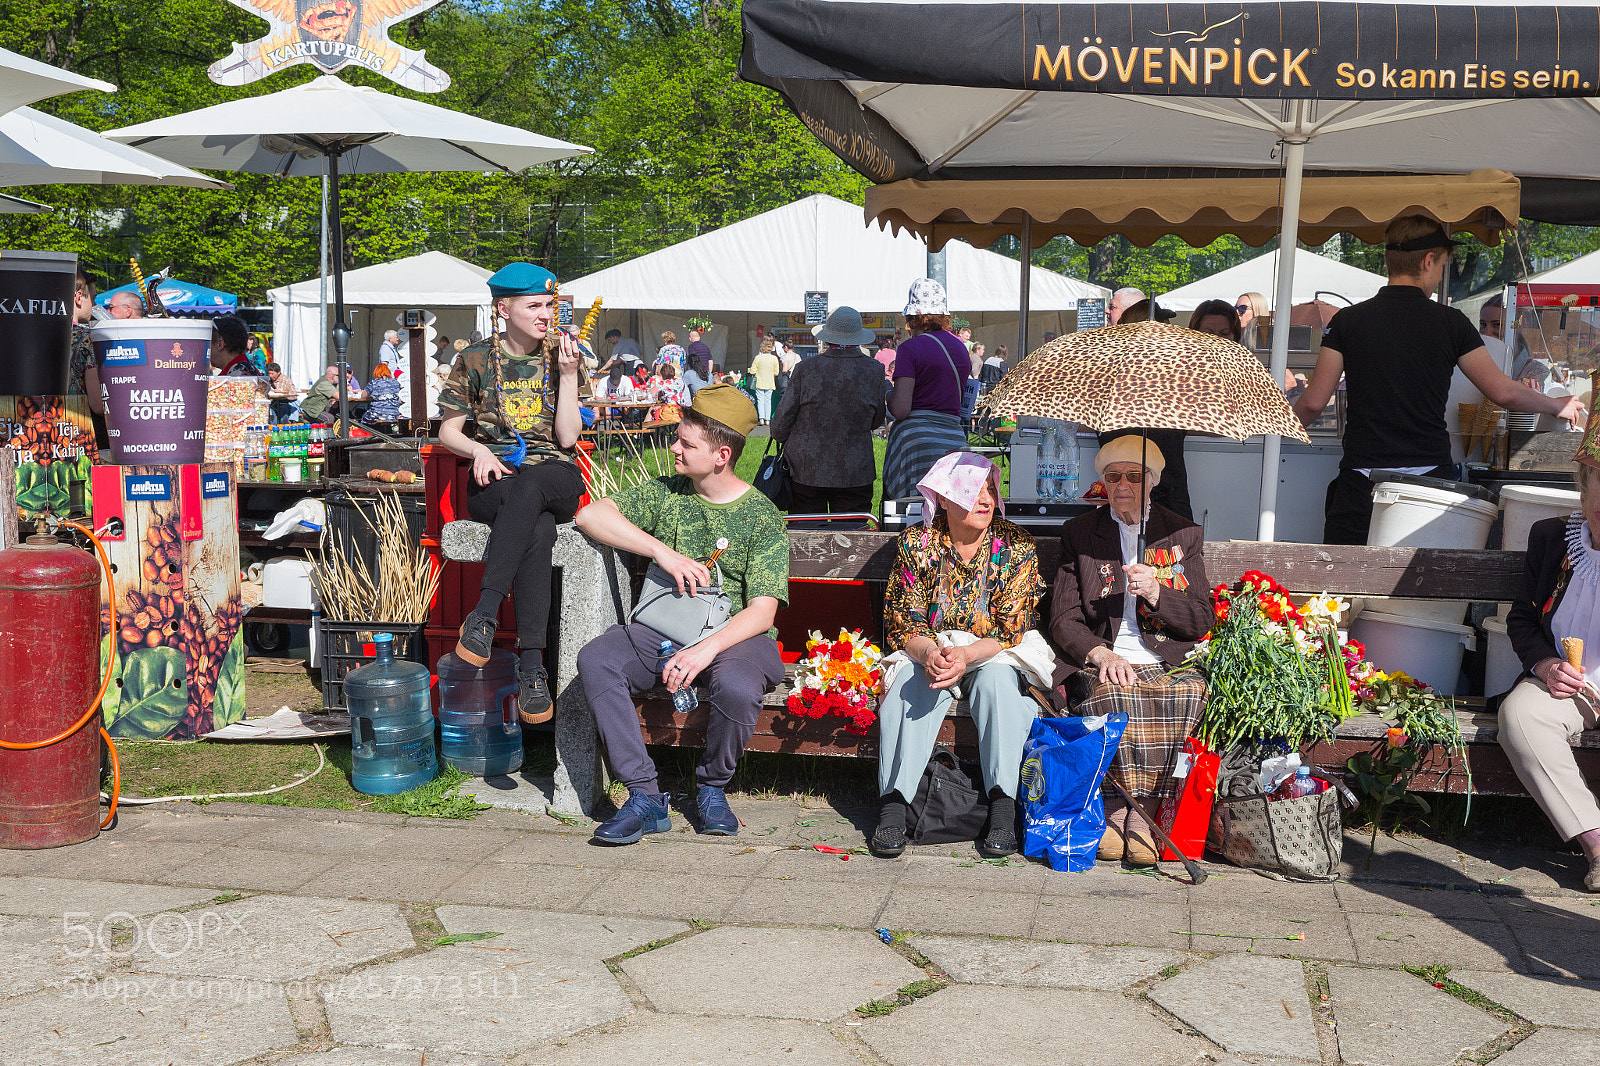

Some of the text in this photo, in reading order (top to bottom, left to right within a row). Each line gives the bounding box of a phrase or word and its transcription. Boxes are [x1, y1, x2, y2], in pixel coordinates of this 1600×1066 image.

[267, 39, 386, 72] KARTUPELIS
[1032, 37, 1312, 87] MÖVENPICK
[1335, 62, 1591, 90] So kann Eis sein.
[106, 346, 140, 357] LAVAZZA
[154, 359, 196, 371] Dallmayr
[111, 376, 137, 385] FRAPPE
[503, 379, 543, 390] РОССИЯ
[130, 389, 184, 403] KAFIJA
[129, 405, 185, 420] COFFEE
[183, 430, 204, 440] LATTE
[52, 443, 86, 462] Kafija
[123, 443, 177, 453] MOCCACINO
[131, 481, 165, 492] LAVAZZA
